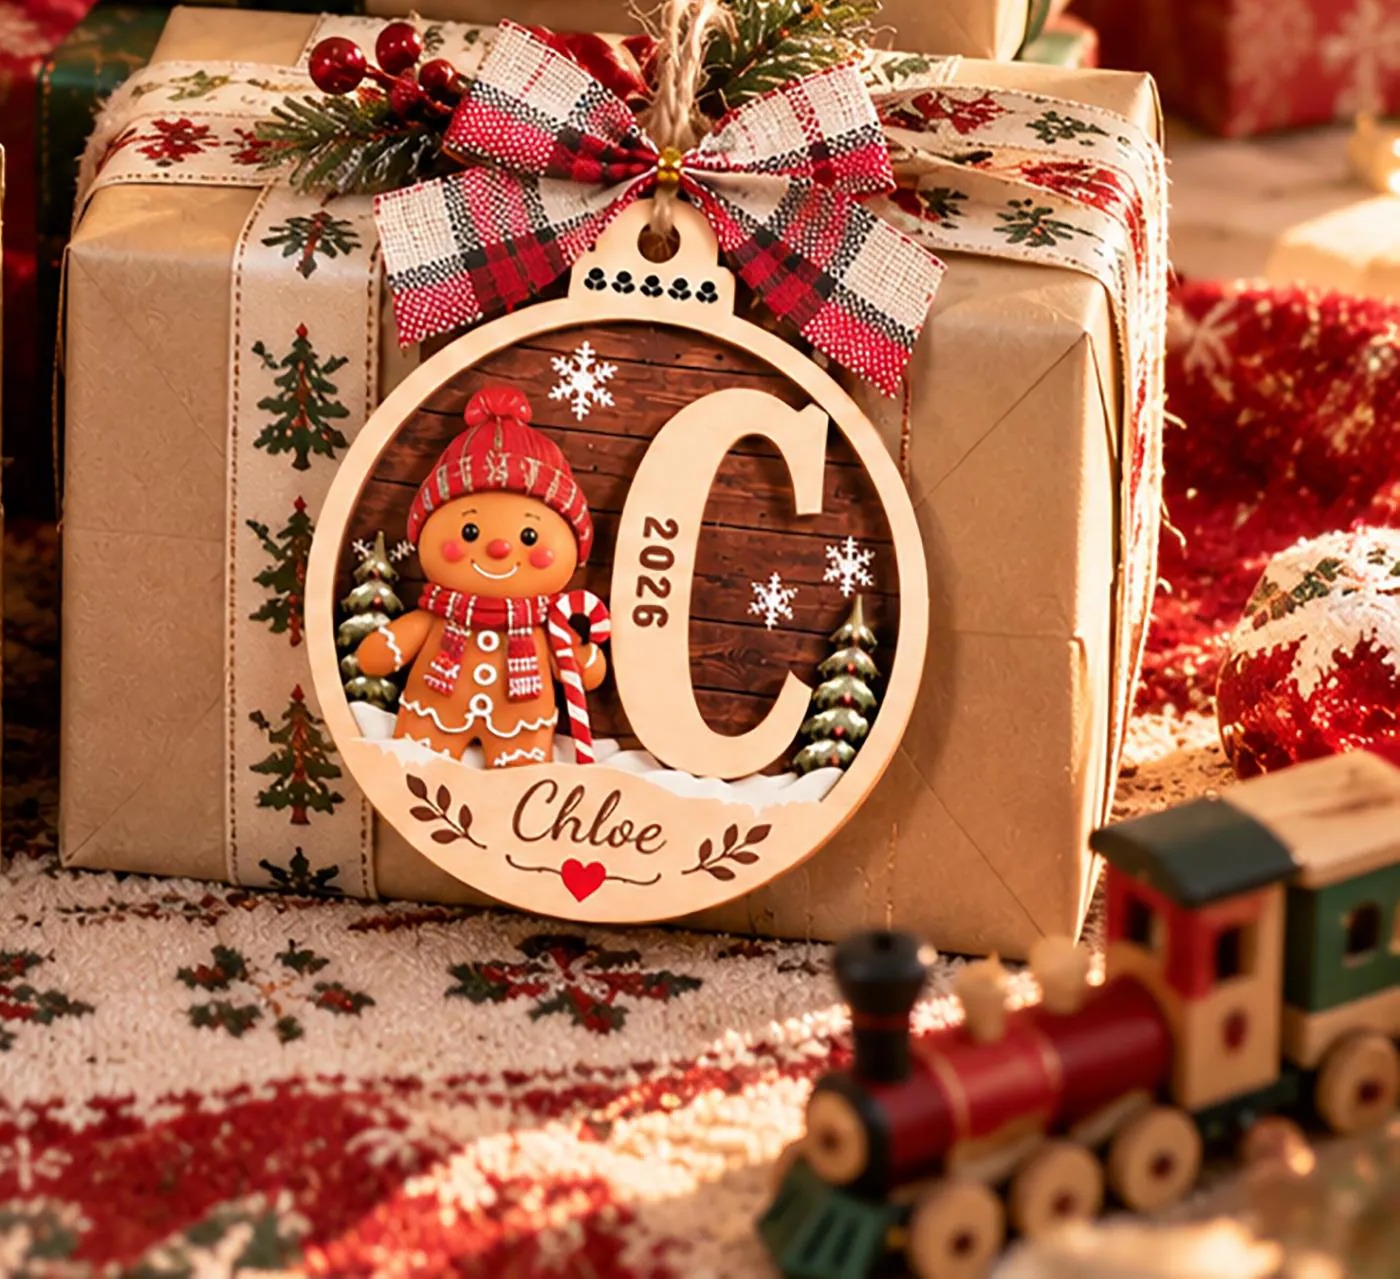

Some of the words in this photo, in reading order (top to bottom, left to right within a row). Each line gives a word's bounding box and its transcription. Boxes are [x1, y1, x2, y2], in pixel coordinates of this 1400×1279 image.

[610, 387, 830, 780] C
[631, 516, 680, 629] 2026
[511, 778, 668, 856] Chloe
